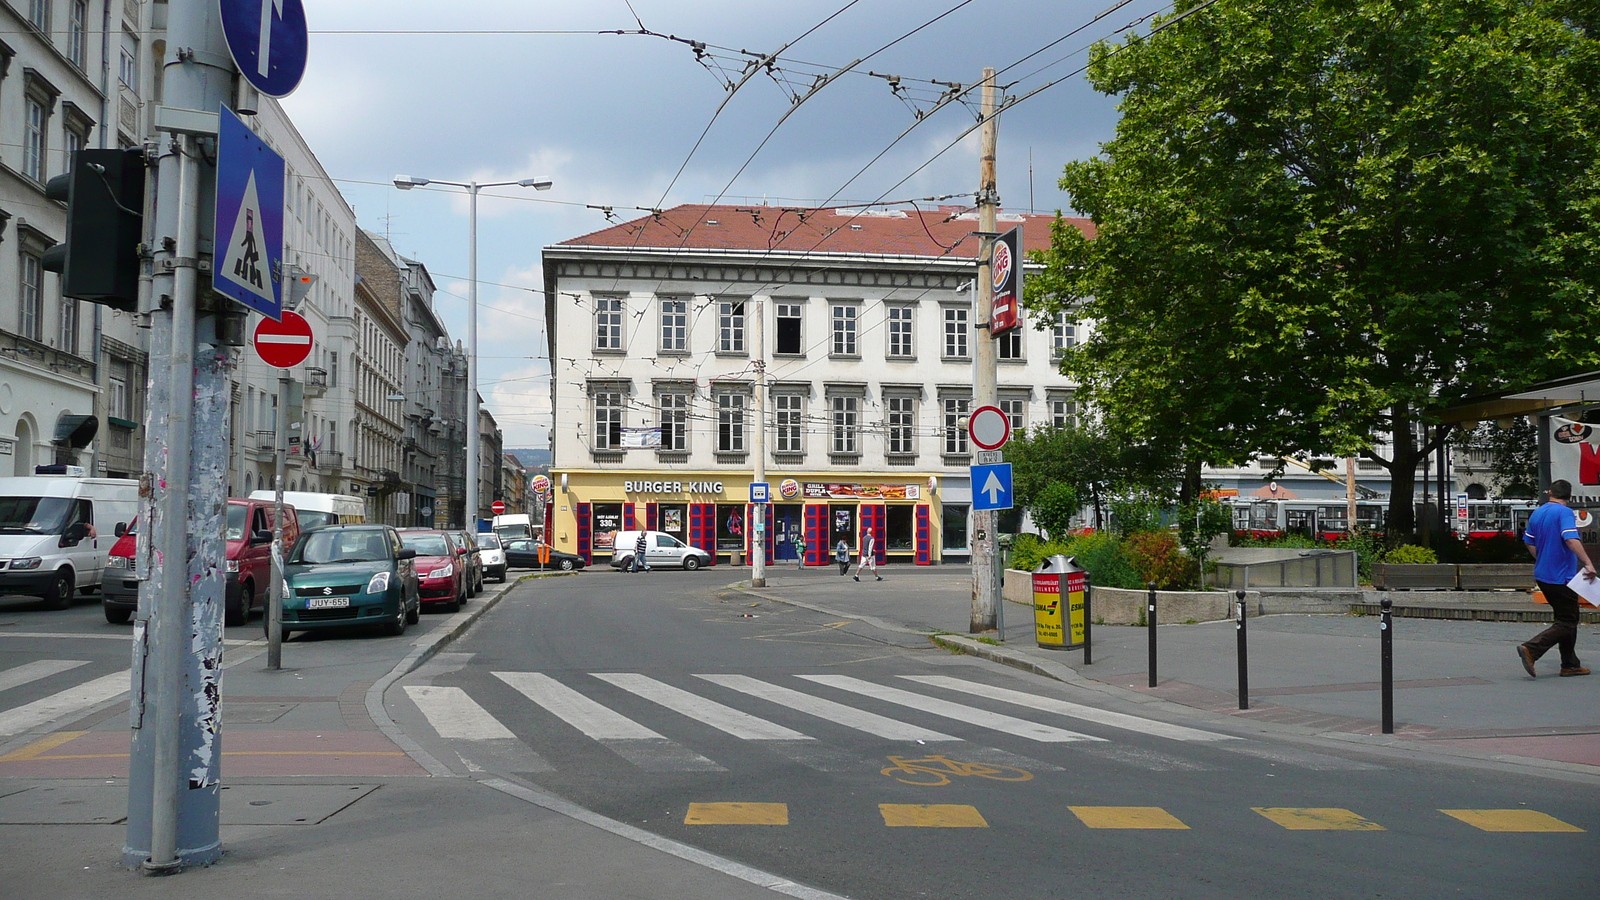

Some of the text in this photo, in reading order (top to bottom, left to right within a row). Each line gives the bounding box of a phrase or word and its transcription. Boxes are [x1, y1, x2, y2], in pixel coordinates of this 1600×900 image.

[533, 482, 549, 490] KING
[624, 481, 723, 494] BURGER KING
[782, 485, 797, 493] KING
[1582, 529, 1598, 544] BÁR
[311, 598, 348, 607] JUY-655
